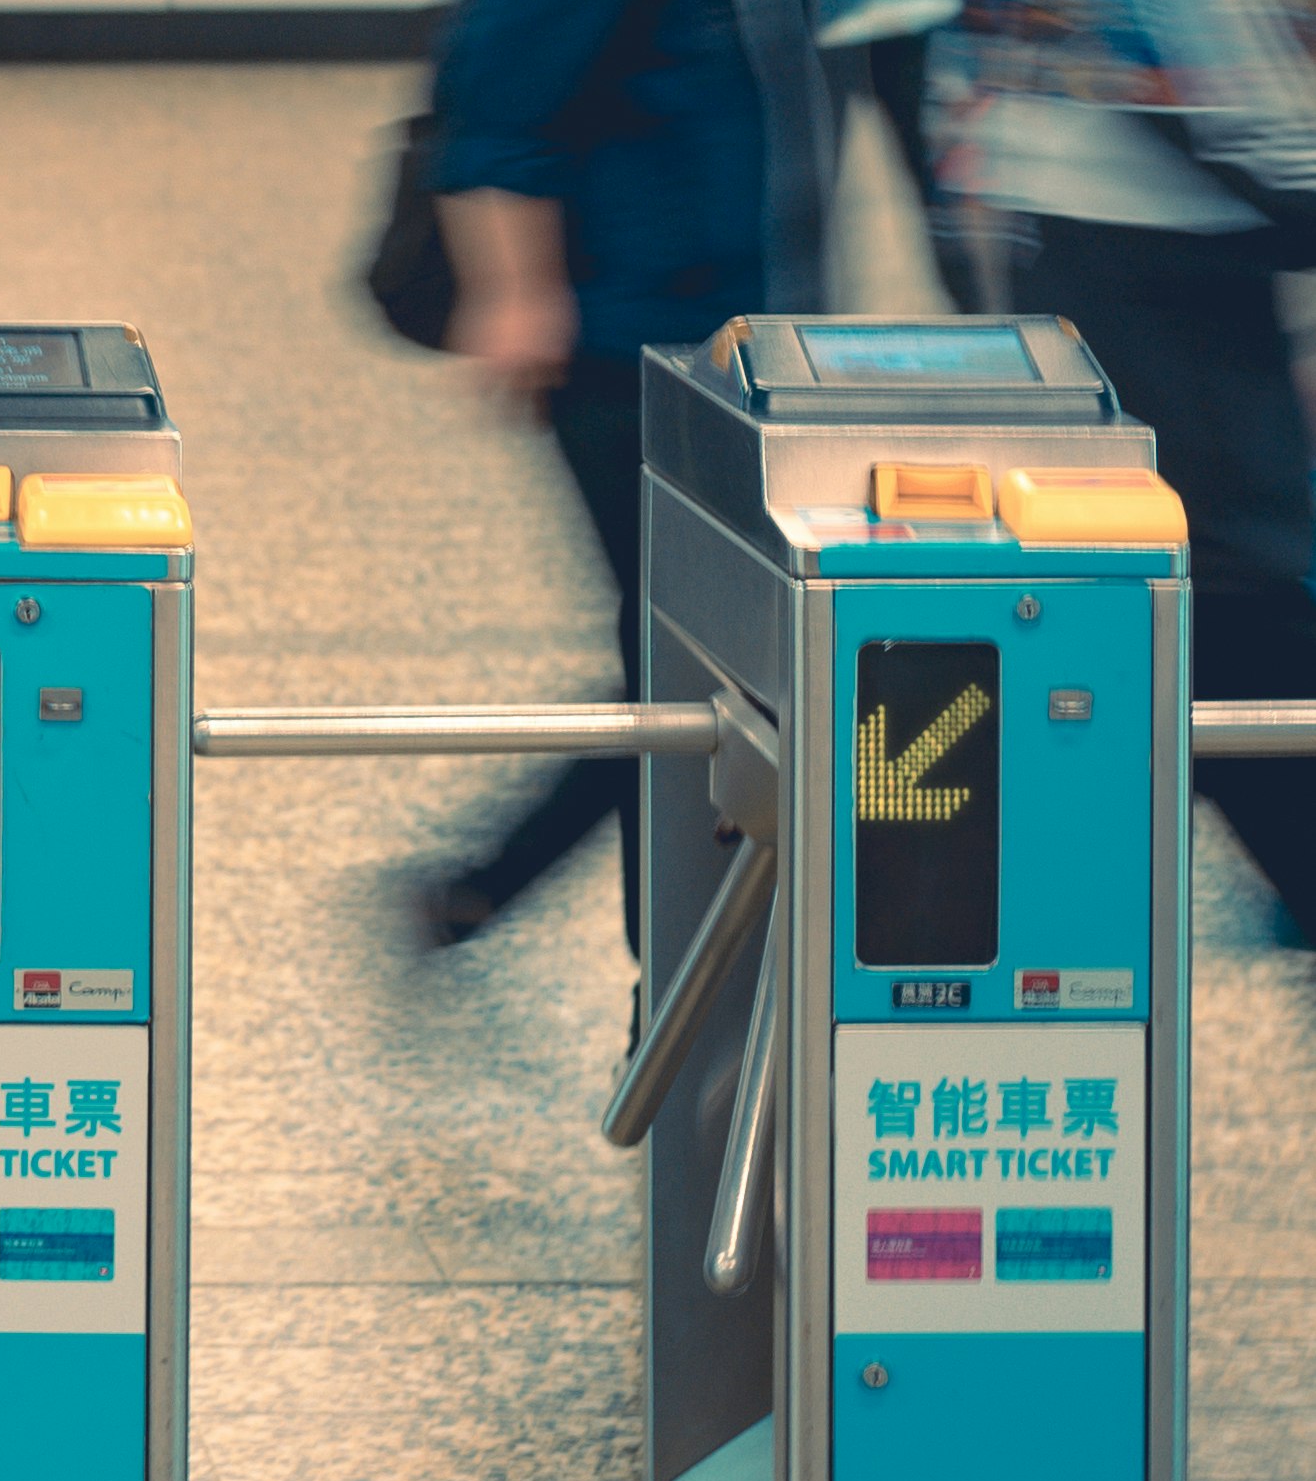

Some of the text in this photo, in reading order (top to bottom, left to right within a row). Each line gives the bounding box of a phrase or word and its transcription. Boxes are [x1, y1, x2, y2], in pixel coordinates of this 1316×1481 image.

[867, 1075, 1119, 1141] 智能車票
[0, 1149, 118, 1179] TICKET
[868, 1148, 1116, 1181] SMART TICKET
